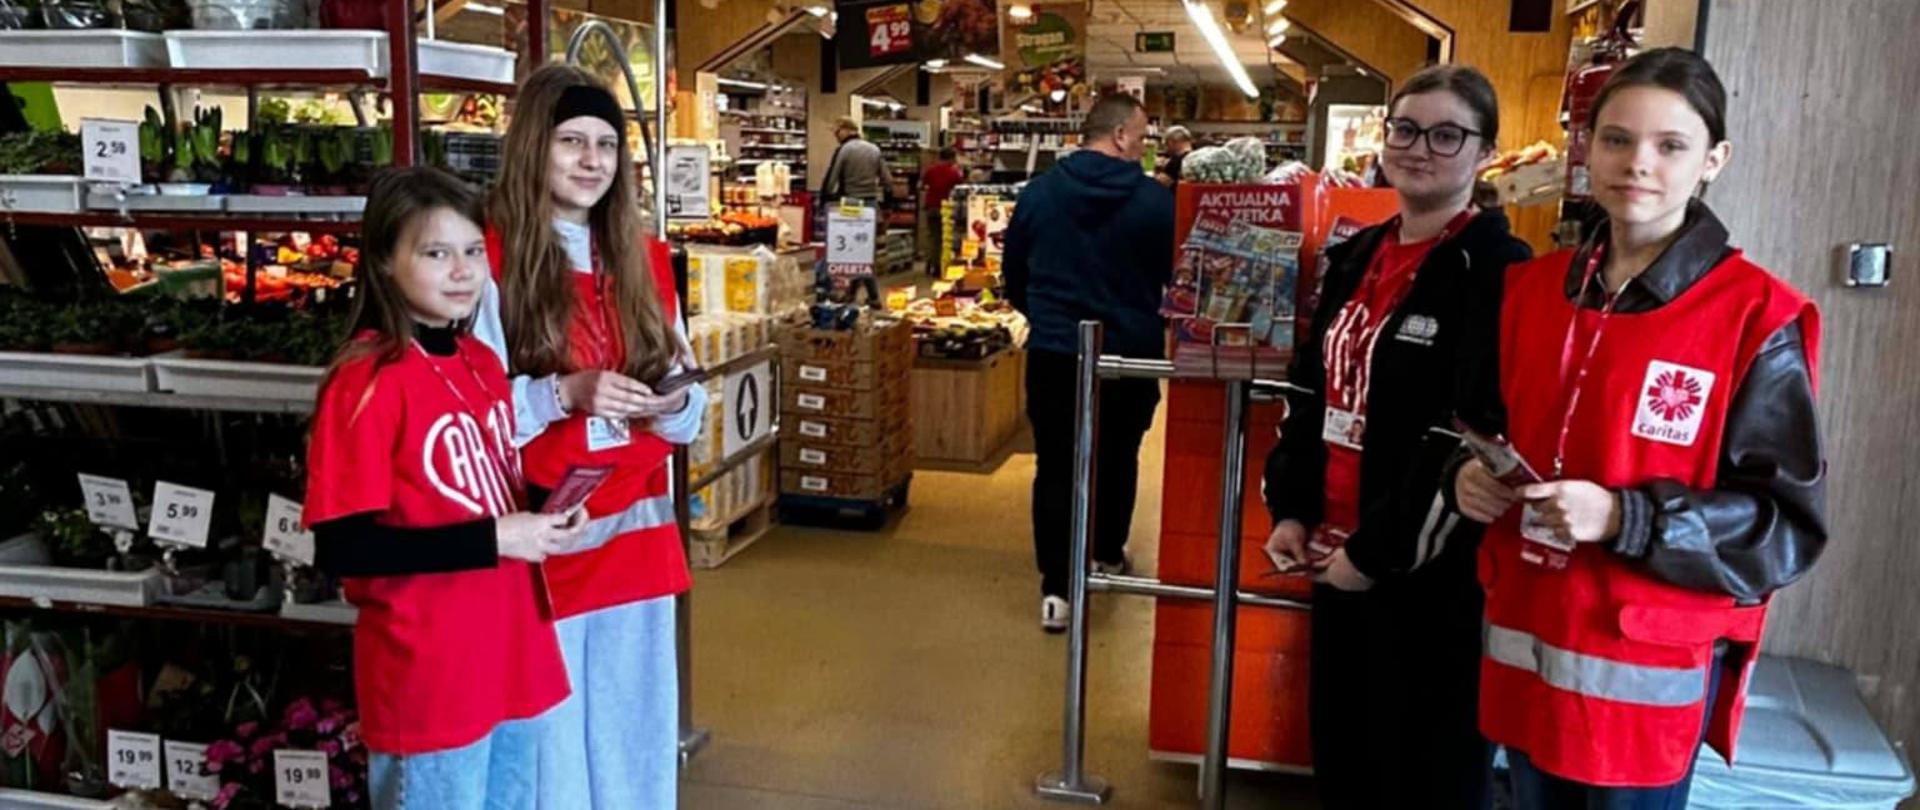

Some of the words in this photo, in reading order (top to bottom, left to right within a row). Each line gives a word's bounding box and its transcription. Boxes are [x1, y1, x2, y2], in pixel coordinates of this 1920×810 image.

[1199, 191, 1291, 207] AKTUALNA
[828, 263, 873, 275] OFERTA
[1637, 422, 1689, 442] caritas
